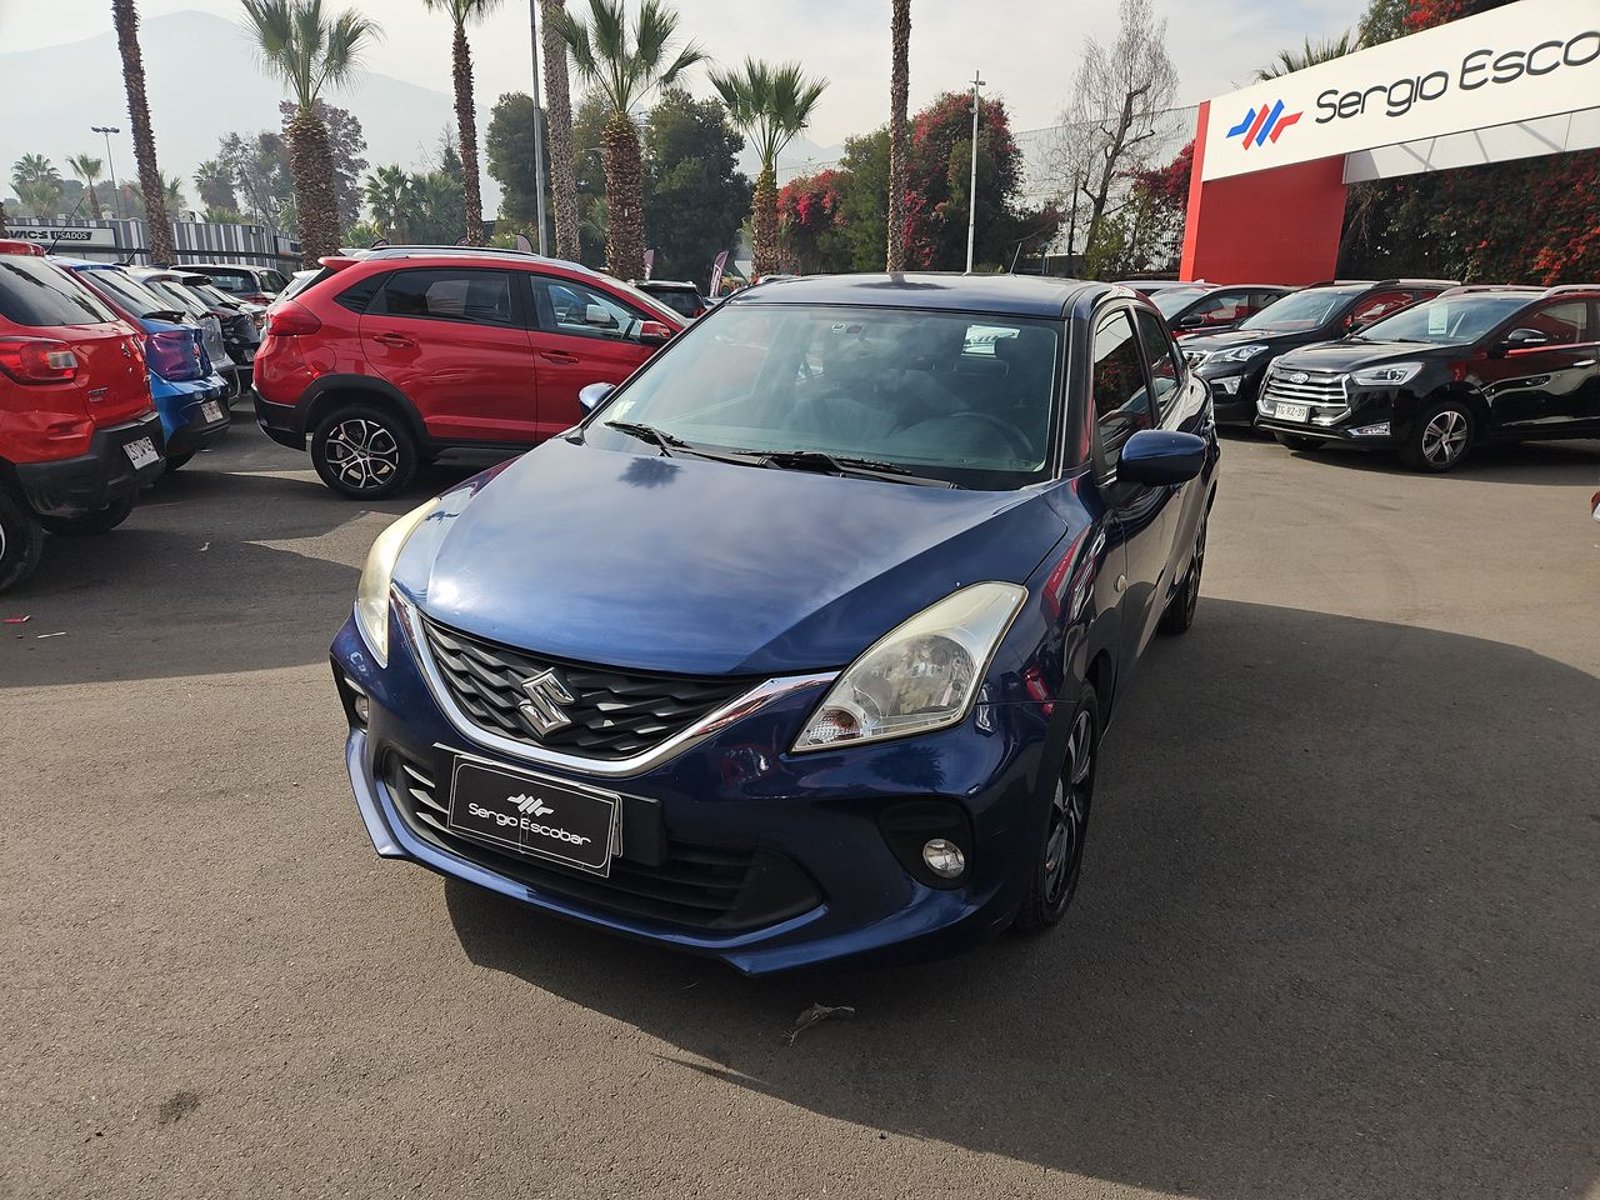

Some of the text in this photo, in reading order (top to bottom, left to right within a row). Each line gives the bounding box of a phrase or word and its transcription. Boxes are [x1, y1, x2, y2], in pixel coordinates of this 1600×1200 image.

[1315, 70, 1450, 125] Sergio
[54, 231, 88, 240] USADOS
[468, 802, 592, 846] Sergio Escobar
